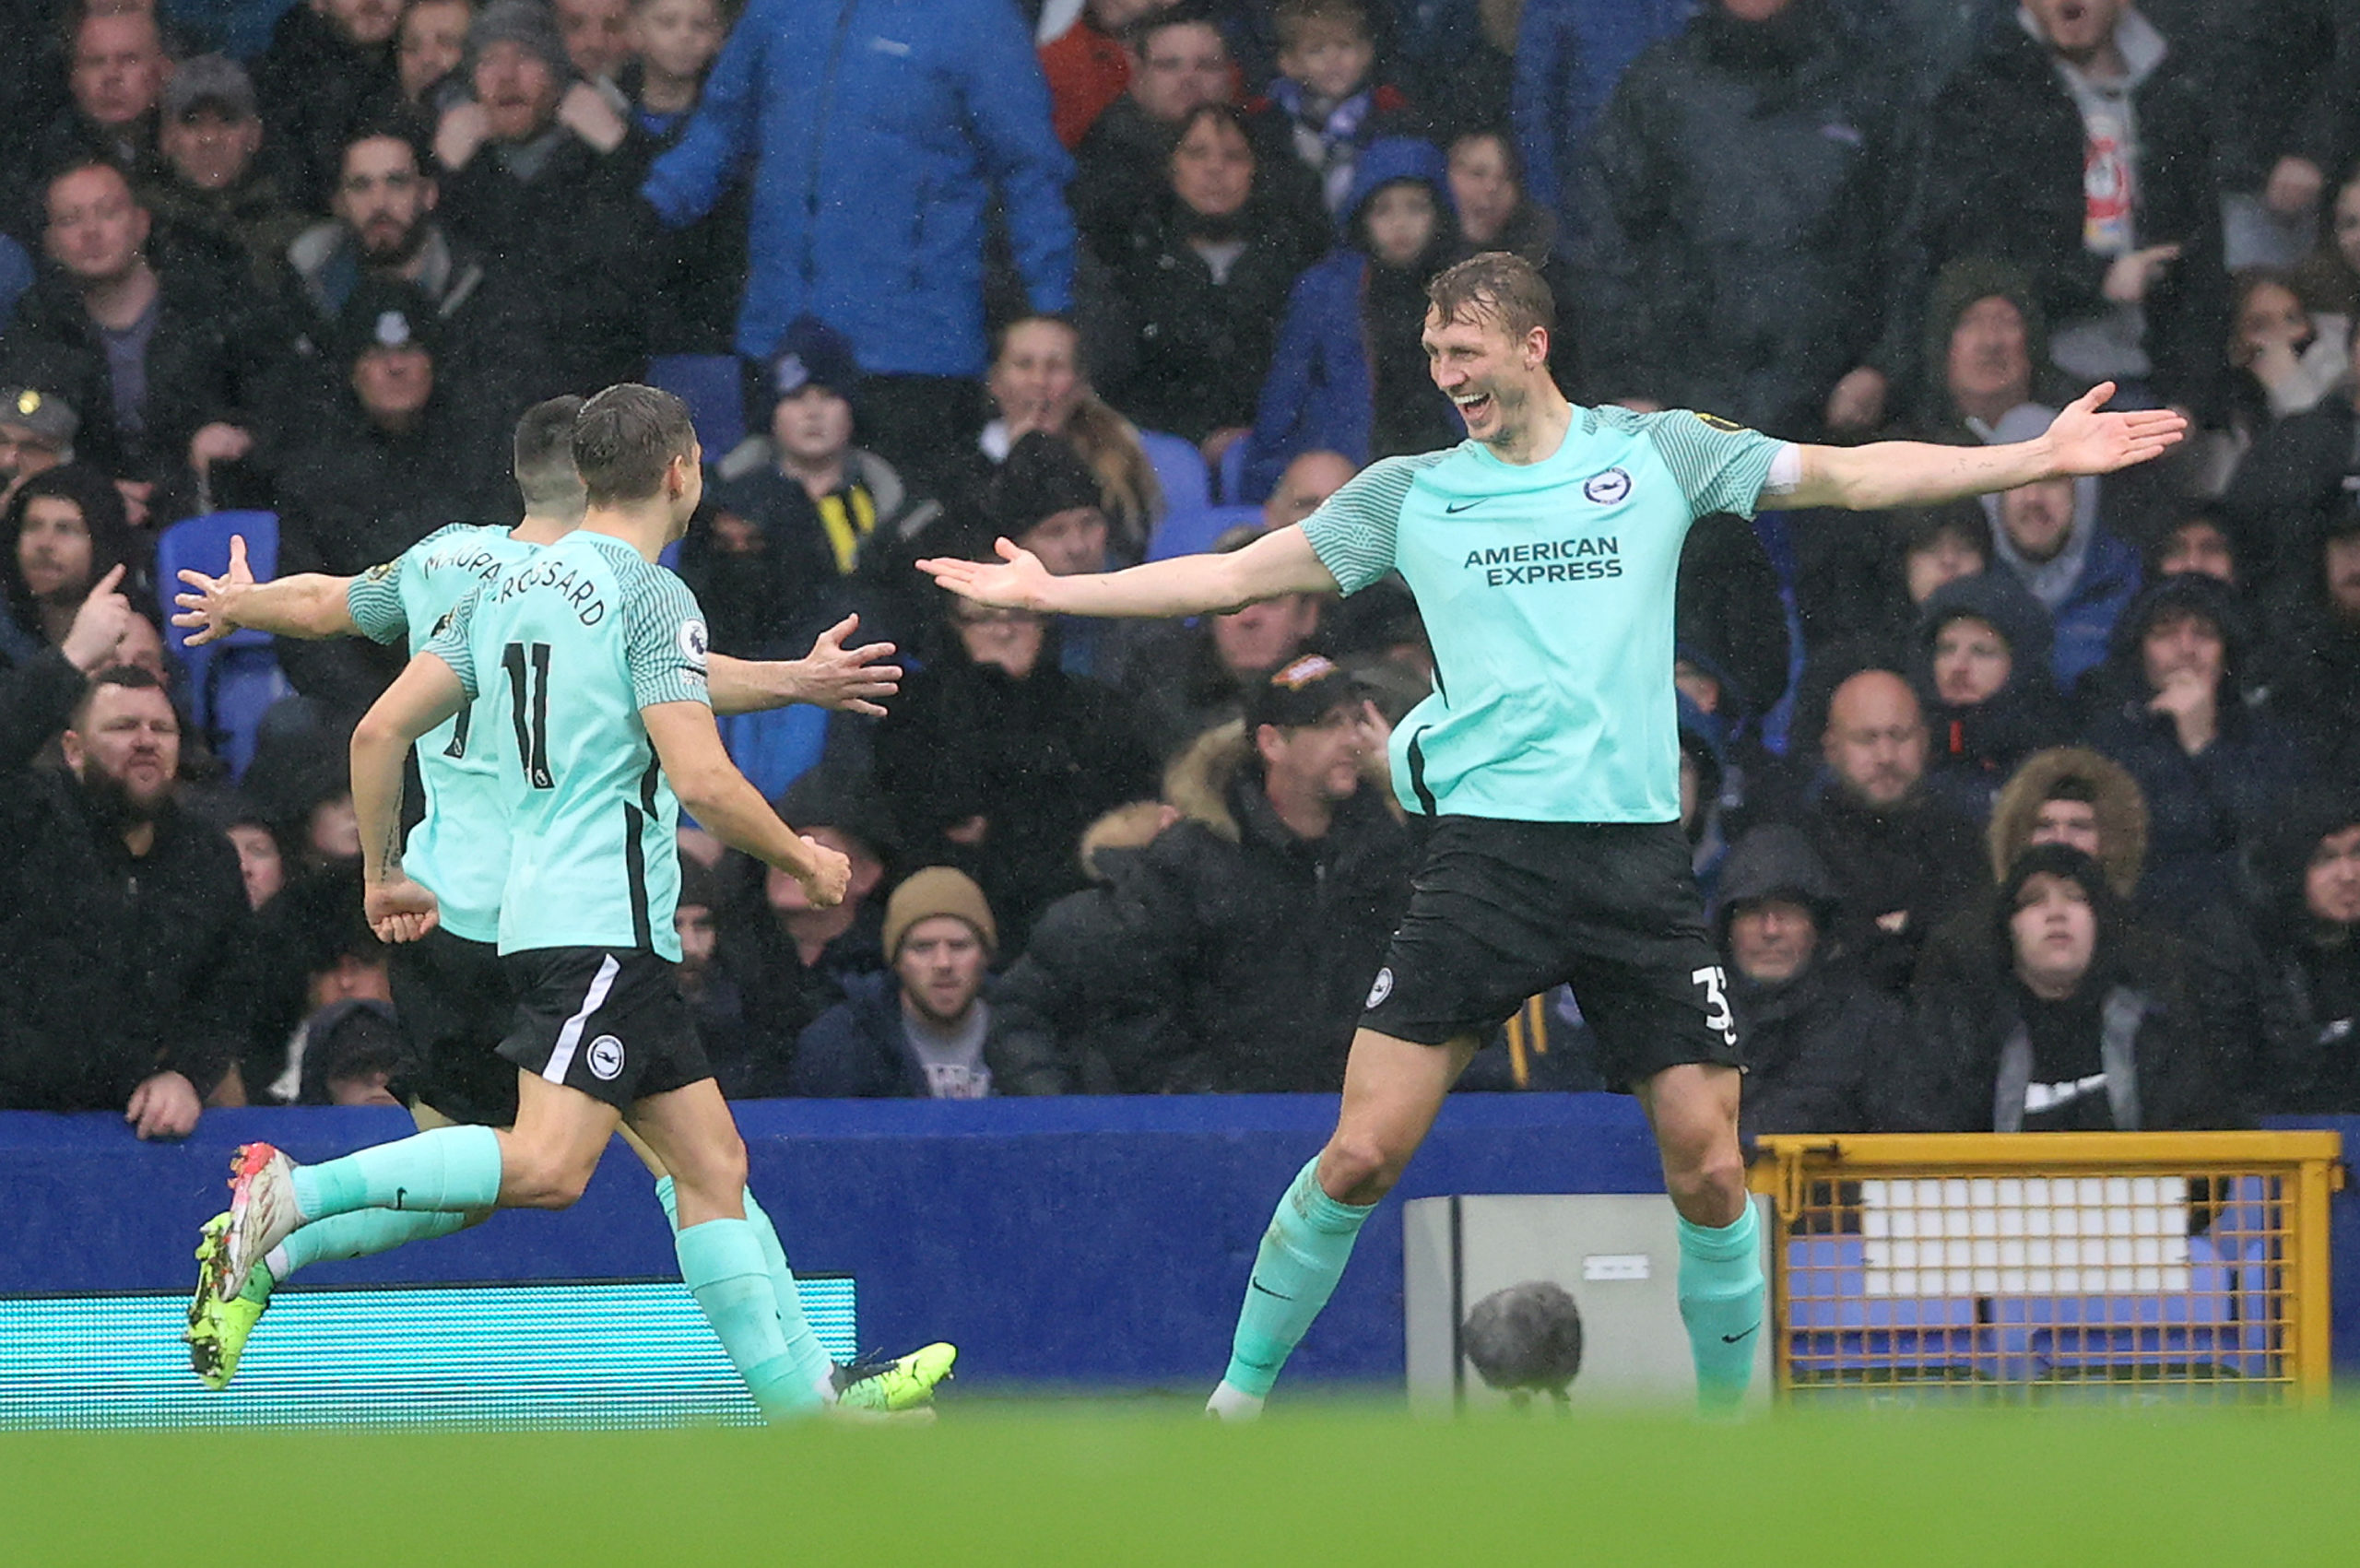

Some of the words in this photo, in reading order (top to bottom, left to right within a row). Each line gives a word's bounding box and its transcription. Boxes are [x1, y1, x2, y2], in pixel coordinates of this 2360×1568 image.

[424, 546, 502, 581] MAUPA
[1464, 536, 1619, 569] AMERICAN
[1486, 559, 1623, 587] EXPRESS
[490, 560, 605, 627] ROSSARD
[501, 642, 556, 789] 11
